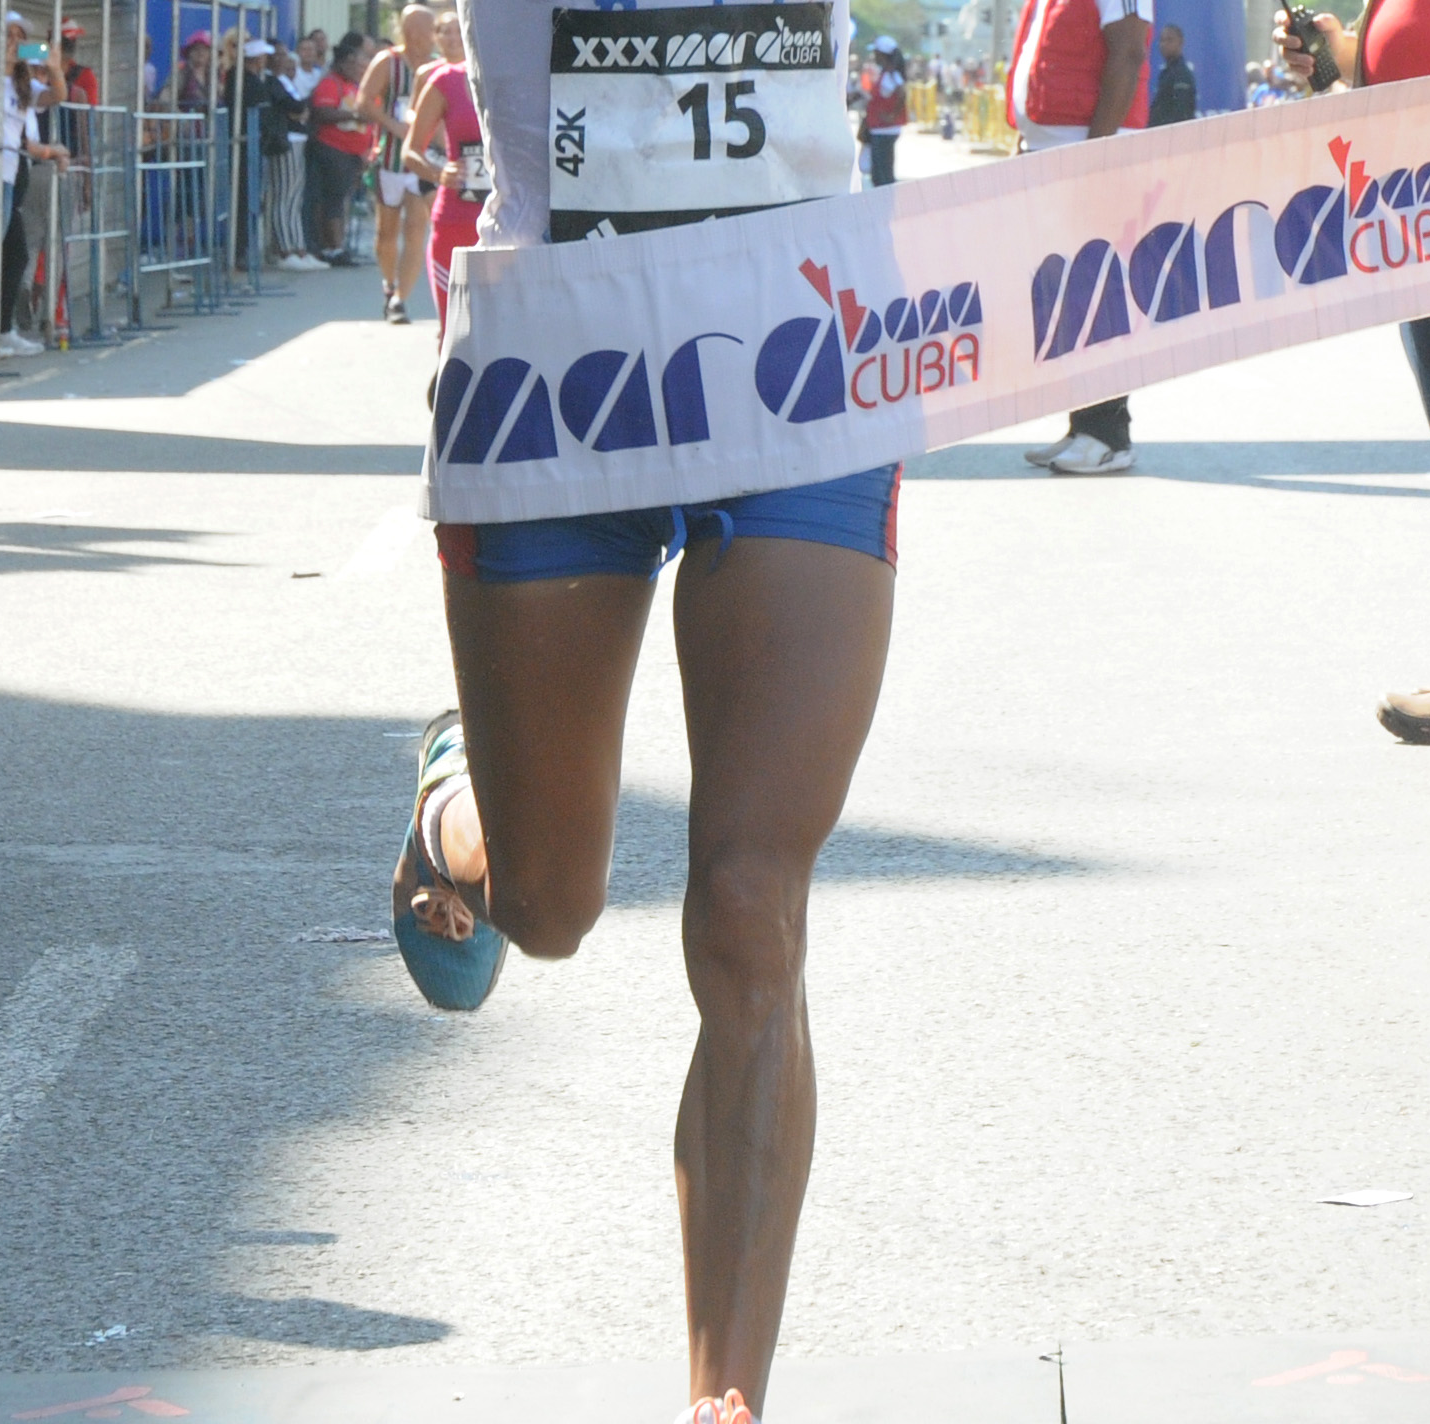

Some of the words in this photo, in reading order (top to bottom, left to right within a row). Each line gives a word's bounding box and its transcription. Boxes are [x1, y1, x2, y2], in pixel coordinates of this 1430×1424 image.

[572, 35, 660, 68] XXX
[781, 46, 821, 65] CUBA
[556, 106, 587, 178] 42K
[676, 79, 767, 161] 15
[849, 332, 980, 410] CUBA
